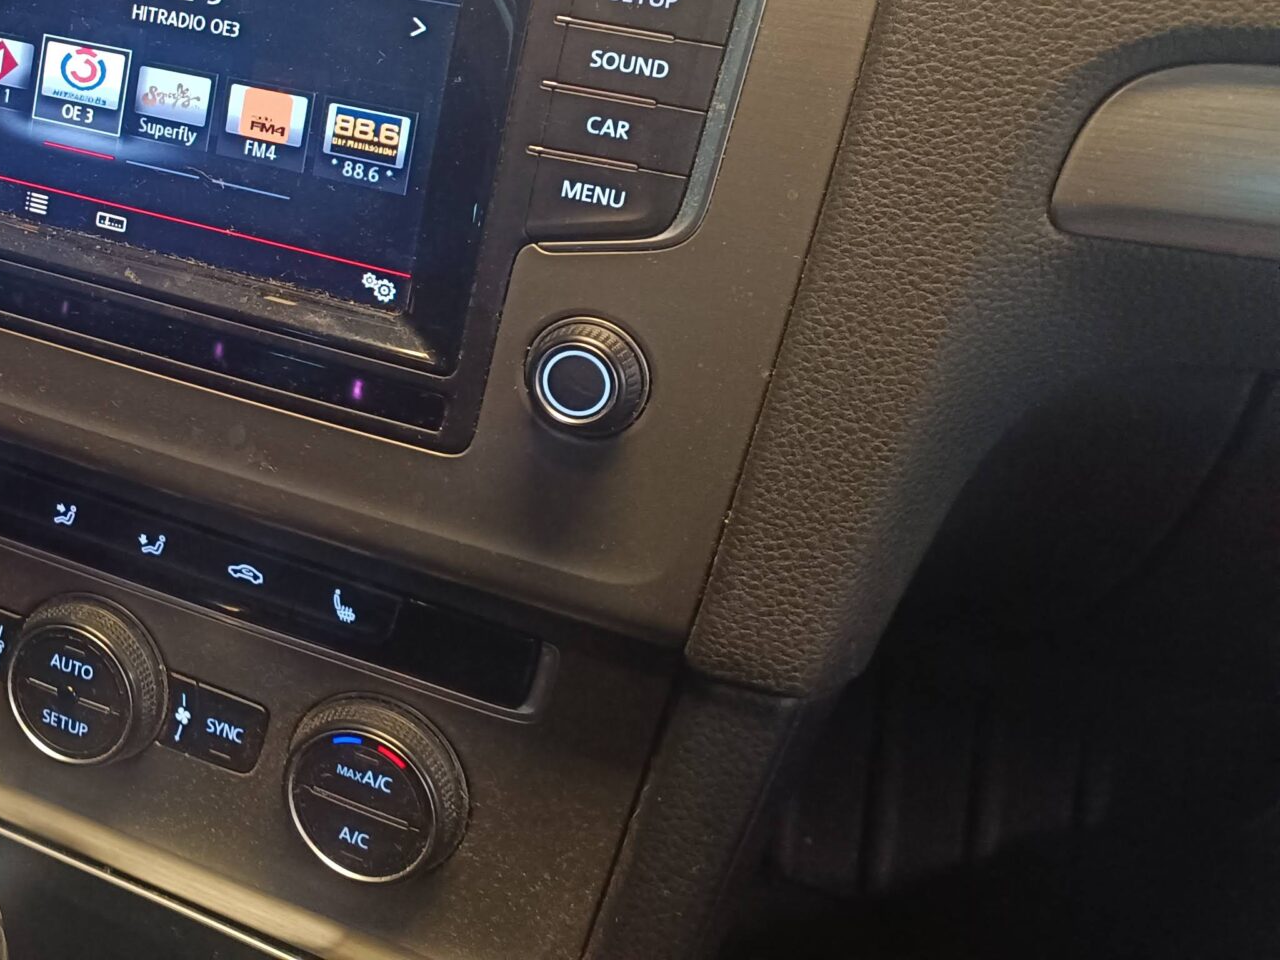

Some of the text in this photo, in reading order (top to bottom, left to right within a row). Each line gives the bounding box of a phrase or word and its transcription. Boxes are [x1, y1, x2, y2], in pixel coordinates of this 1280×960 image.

[132, 4, 241, 38] HITRADIO OE3
[589, 49, 669, 79] SOUND
[4, 89, 10, 103] 1
[62, 103, 94, 123] OE 3
[138, 117, 198, 147] Superfly
[250, 120, 286, 137] FM4
[335, 114, 400, 146] 88.6
[586, 116, 630, 140] CAR
[244, 139, 277, 161] FM4
[342, 160, 380, 183] 88.6
[561, 180, 626, 208] MENU
[50, 653, 94, 680] AUTO
[42, 709, 89, 738] SETUP
[205, 718, 244, 744] SYNC
[362, 771, 393, 793] A/C
[338, 827, 370, 849] A/C
